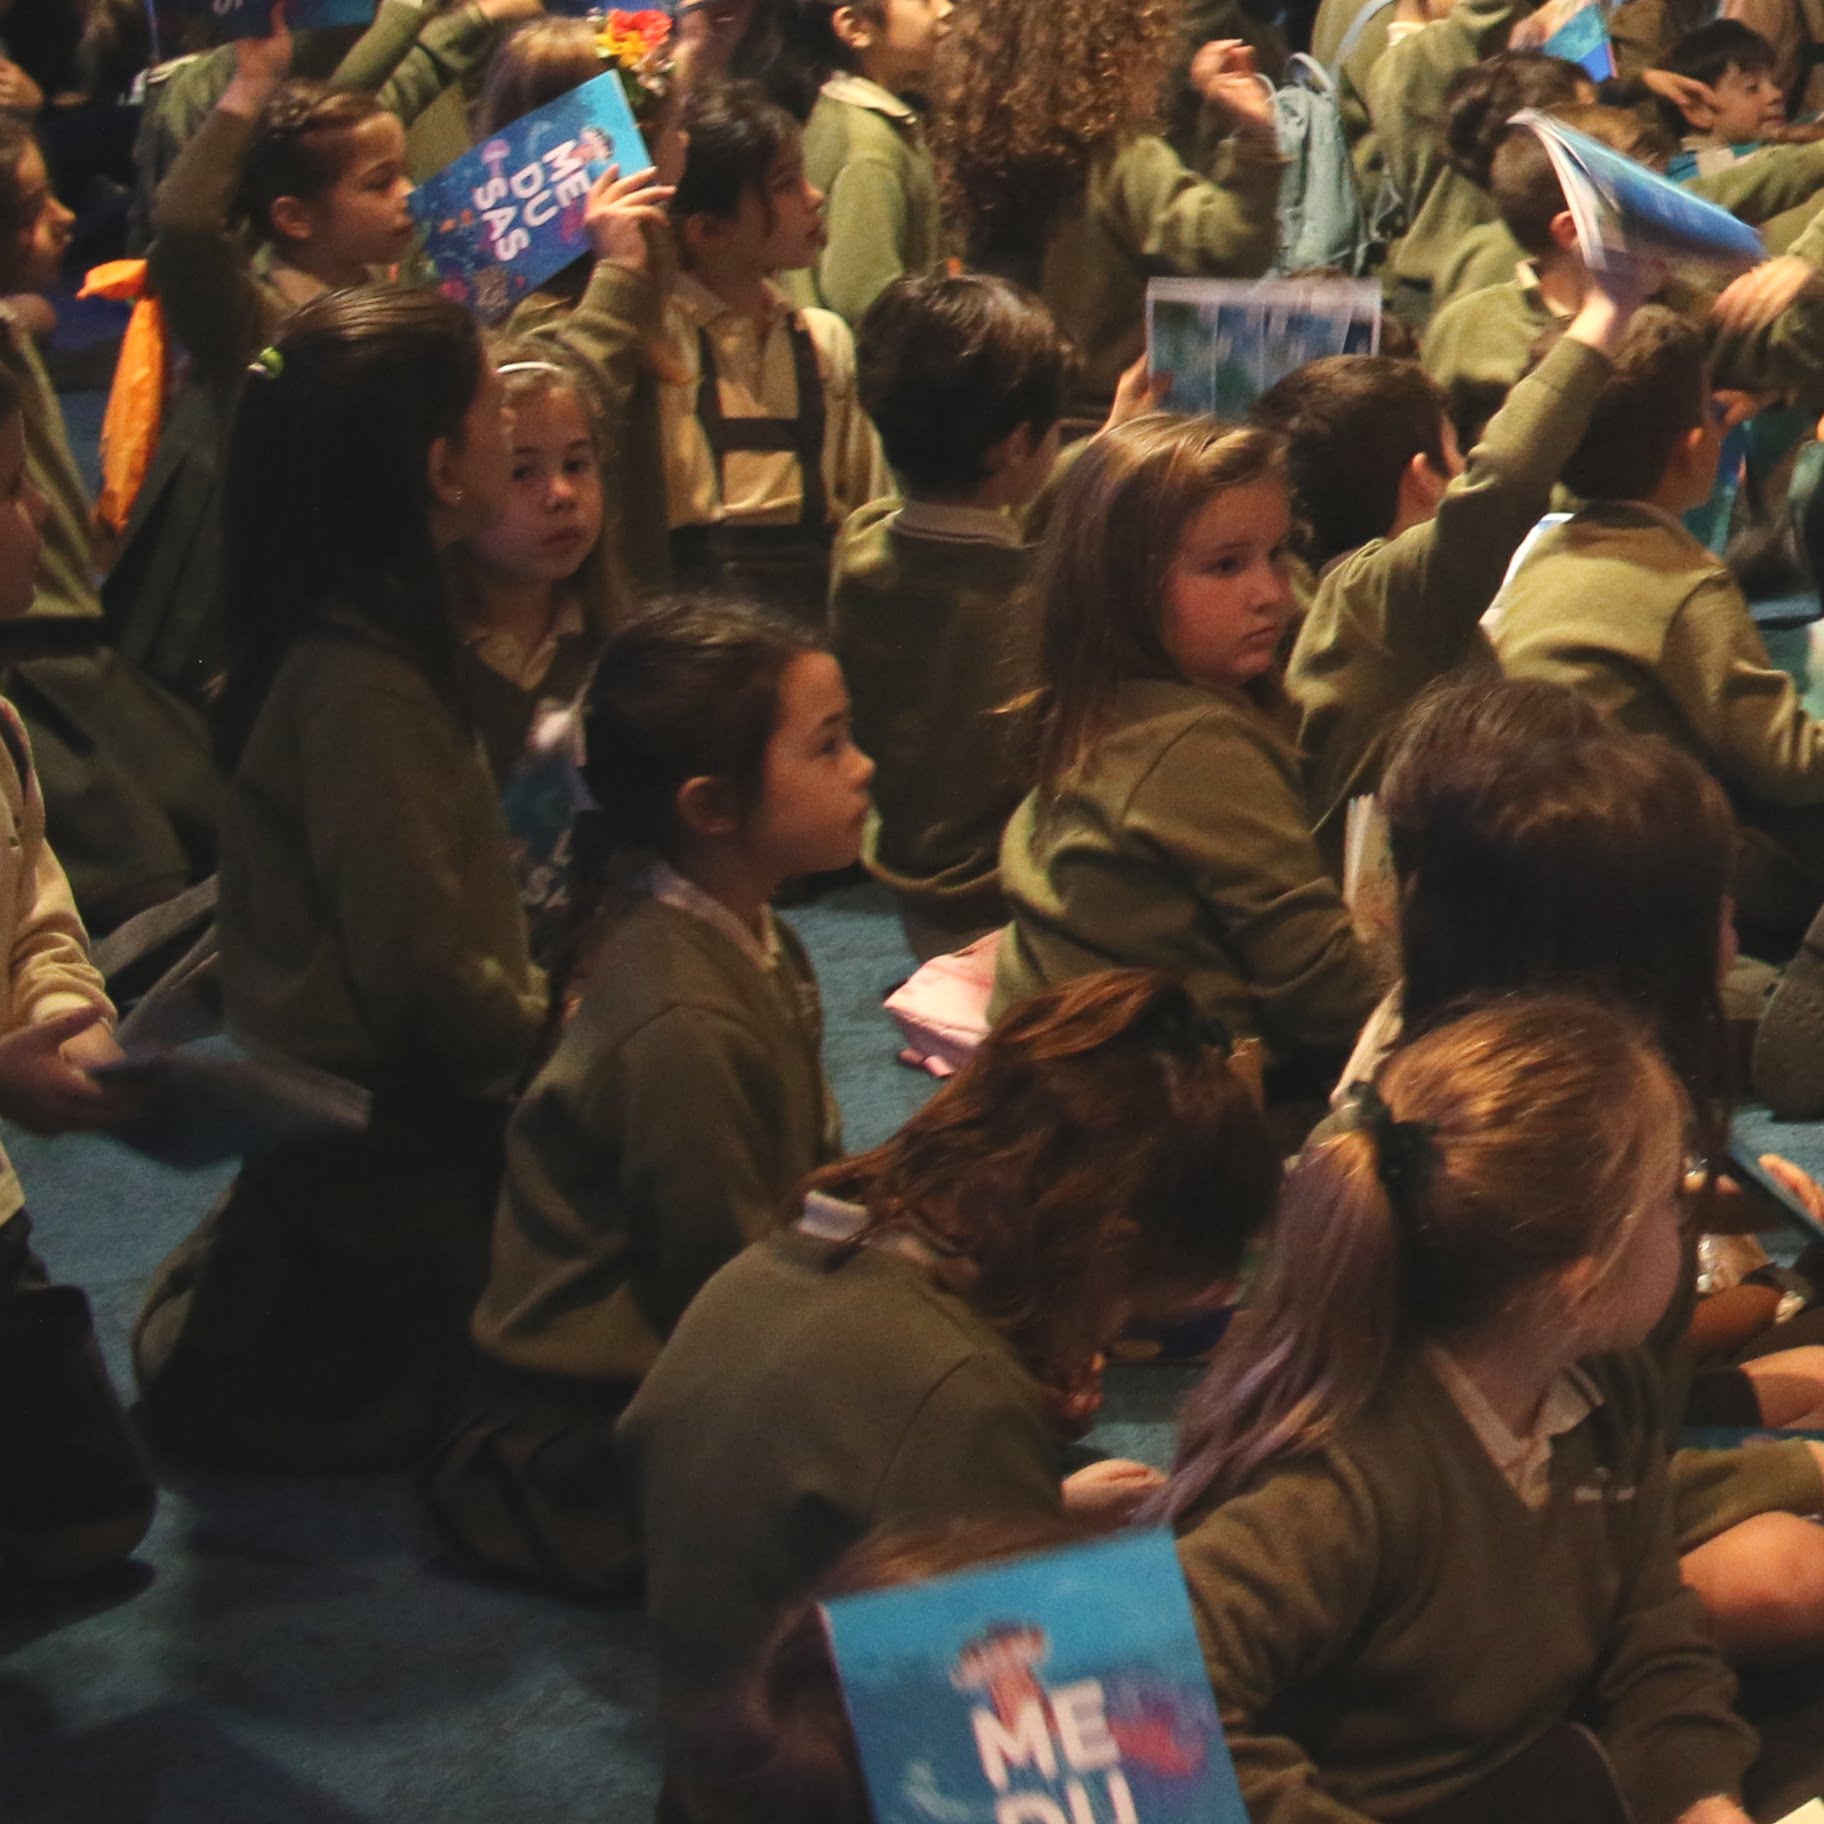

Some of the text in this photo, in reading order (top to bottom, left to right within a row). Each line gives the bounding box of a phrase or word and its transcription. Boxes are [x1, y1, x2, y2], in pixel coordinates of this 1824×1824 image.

[508, 161, 560, 228] DU
[541, 140, 594, 209] ME
[472, 176, 531, 263] SAS
[971, 1675, 1121, 1791] ME
